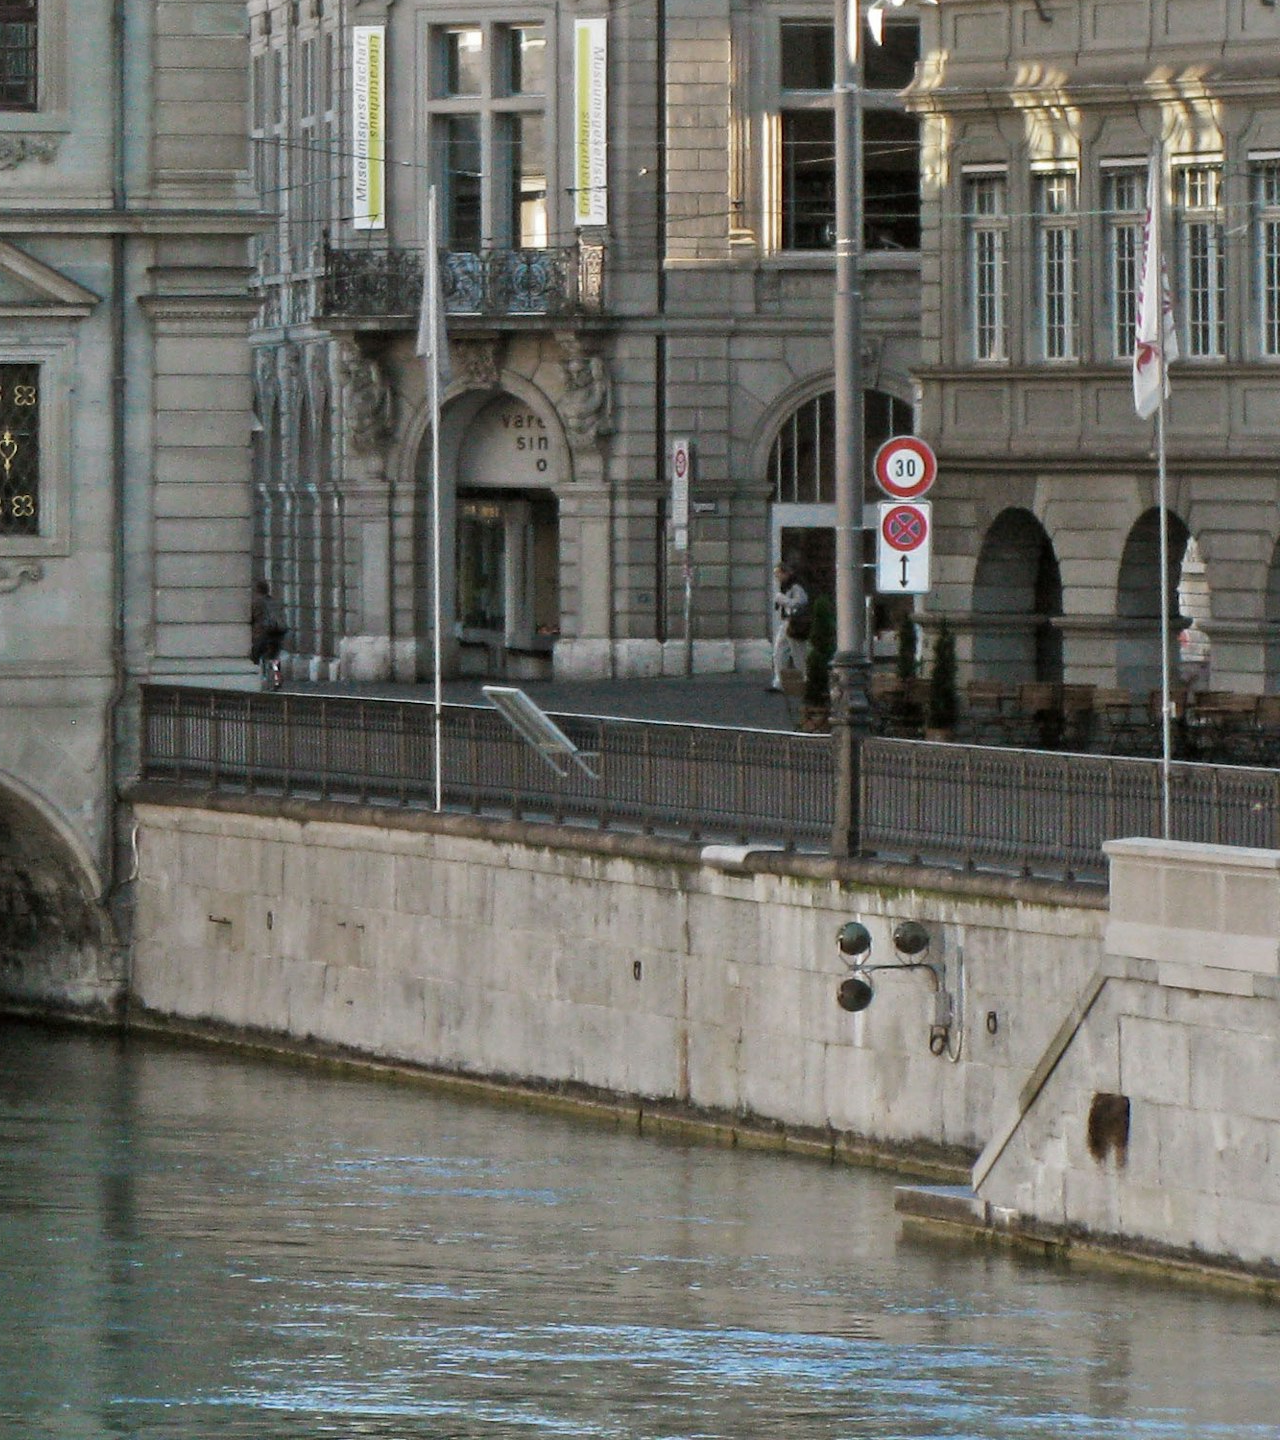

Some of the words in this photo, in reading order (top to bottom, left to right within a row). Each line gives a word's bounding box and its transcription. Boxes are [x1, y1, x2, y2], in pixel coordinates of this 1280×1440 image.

[356, 35, 367, 202] Museumsgesellschaft
[370, 35, 380, 137] Literaturhaus
[580, 111, 590, 216] Literaturhaus
[895, 459, 916, 477] 30
